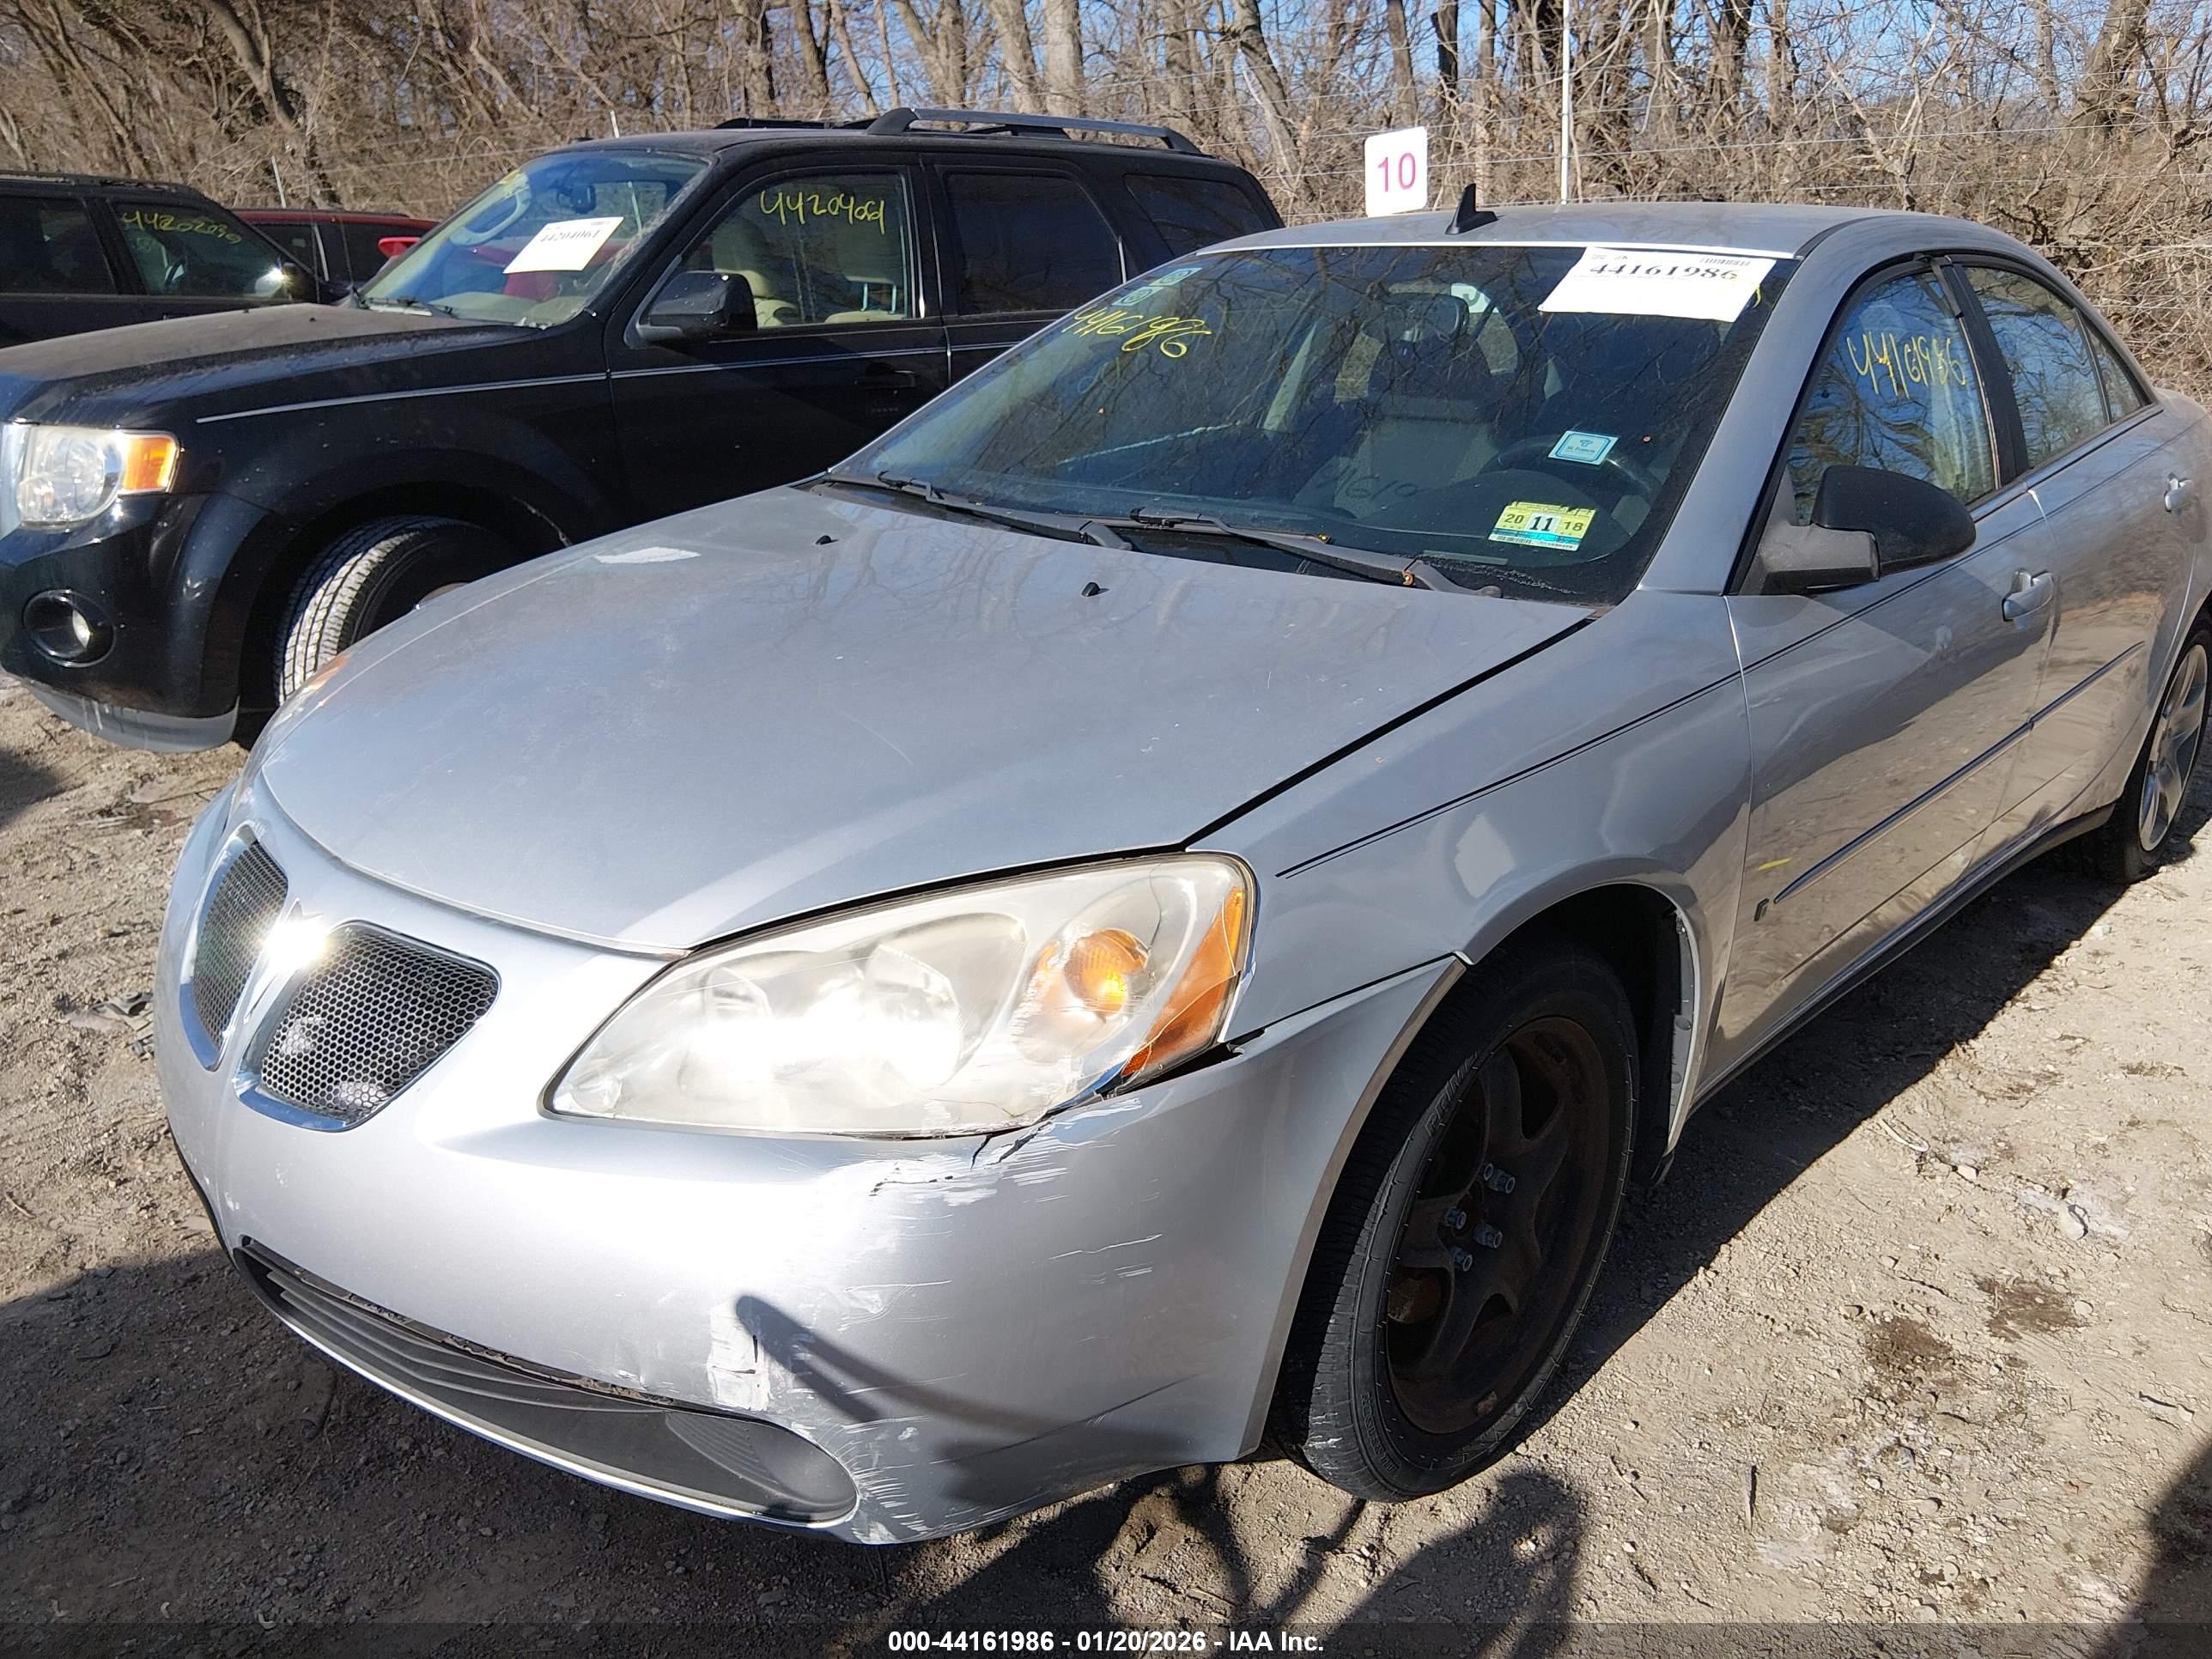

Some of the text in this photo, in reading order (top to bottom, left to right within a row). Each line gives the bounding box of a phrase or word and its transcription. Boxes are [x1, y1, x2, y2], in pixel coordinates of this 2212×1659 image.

[1377, 152, 1417, 193] 10
[1589, 263, 1738, 280] 44161986
[1504, 514, 1584, 532] 20 11 18
